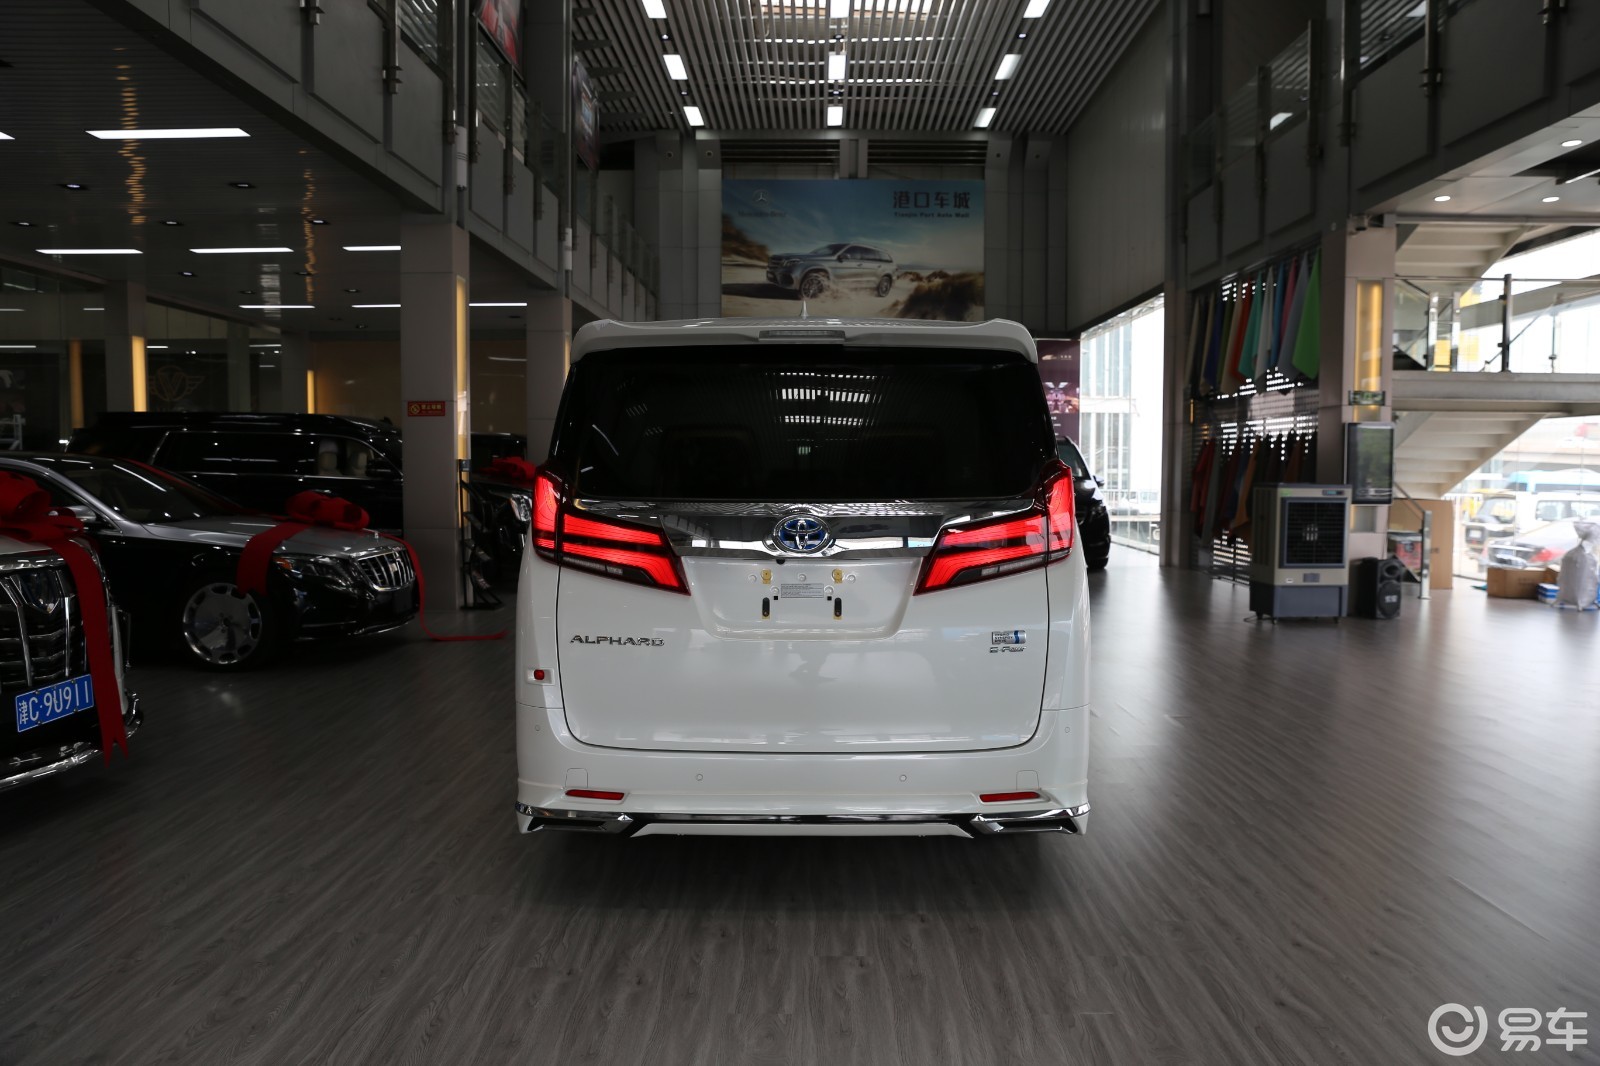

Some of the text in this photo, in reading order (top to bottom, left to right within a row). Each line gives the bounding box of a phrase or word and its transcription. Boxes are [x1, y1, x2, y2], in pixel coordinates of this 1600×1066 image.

[893, 190, 970, 209] 港口车城
[569, 634, 665, 647] ALPHARD
